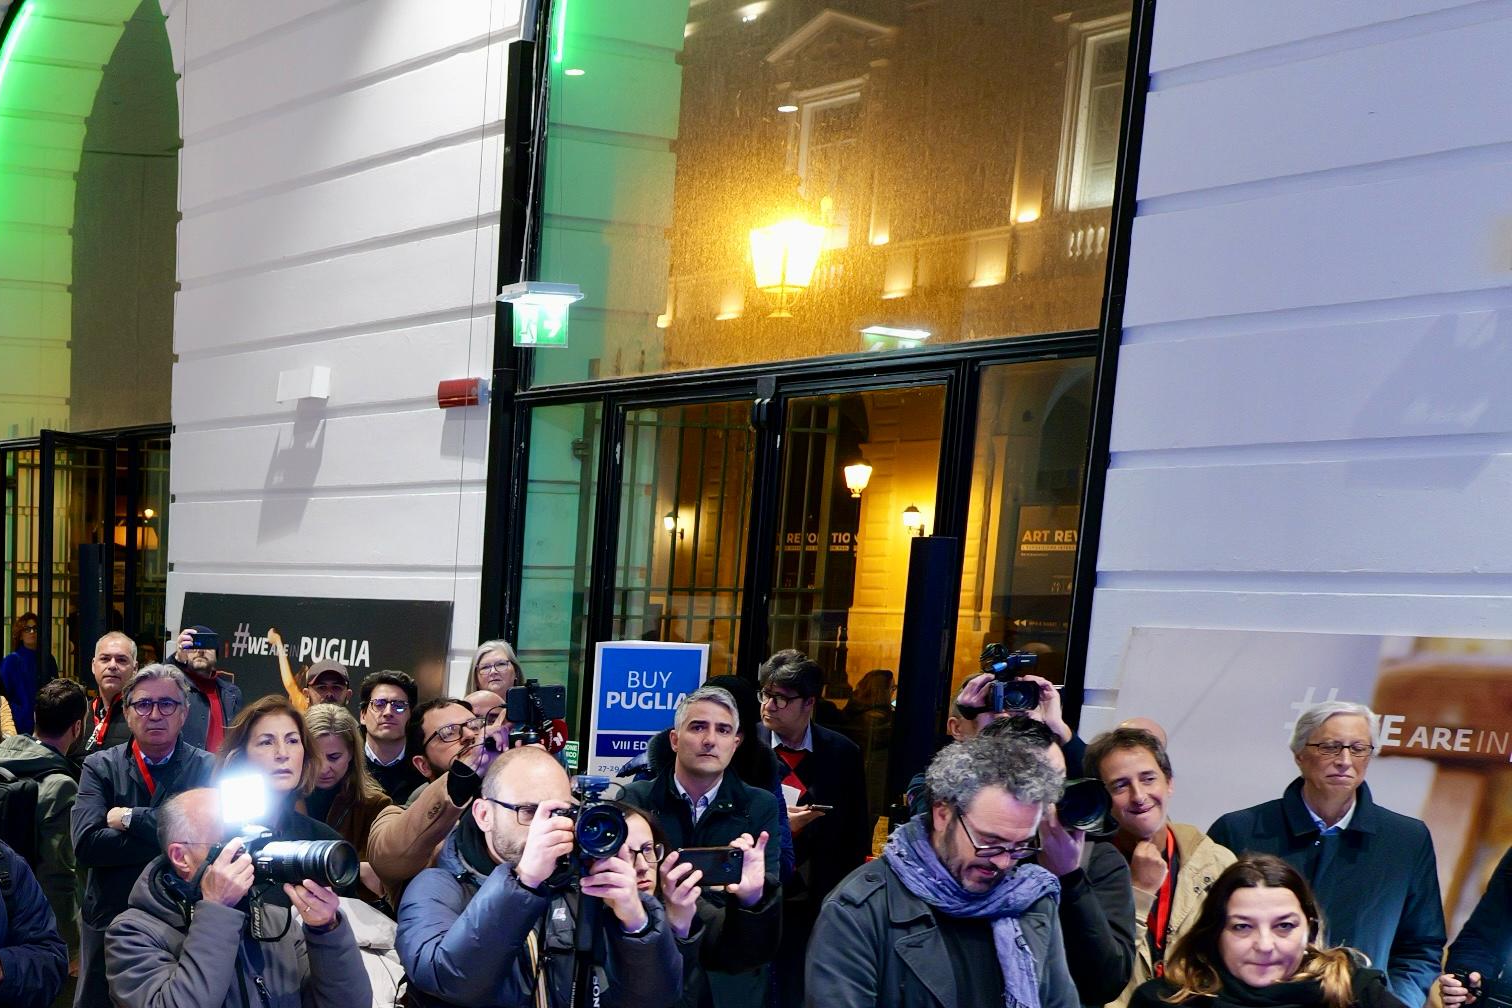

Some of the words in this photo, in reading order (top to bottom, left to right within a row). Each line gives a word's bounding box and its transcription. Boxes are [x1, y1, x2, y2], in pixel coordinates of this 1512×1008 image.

[1022, 530, 1050, 542] ART
[298, 636, 370, 668] PUGLIA
[627, 671, 672, 689] BUY
[612, 741, 630, 750] VIII
[1406, 726, 1473, 752] ARE
[253, 906, 262, 938] Nikon
